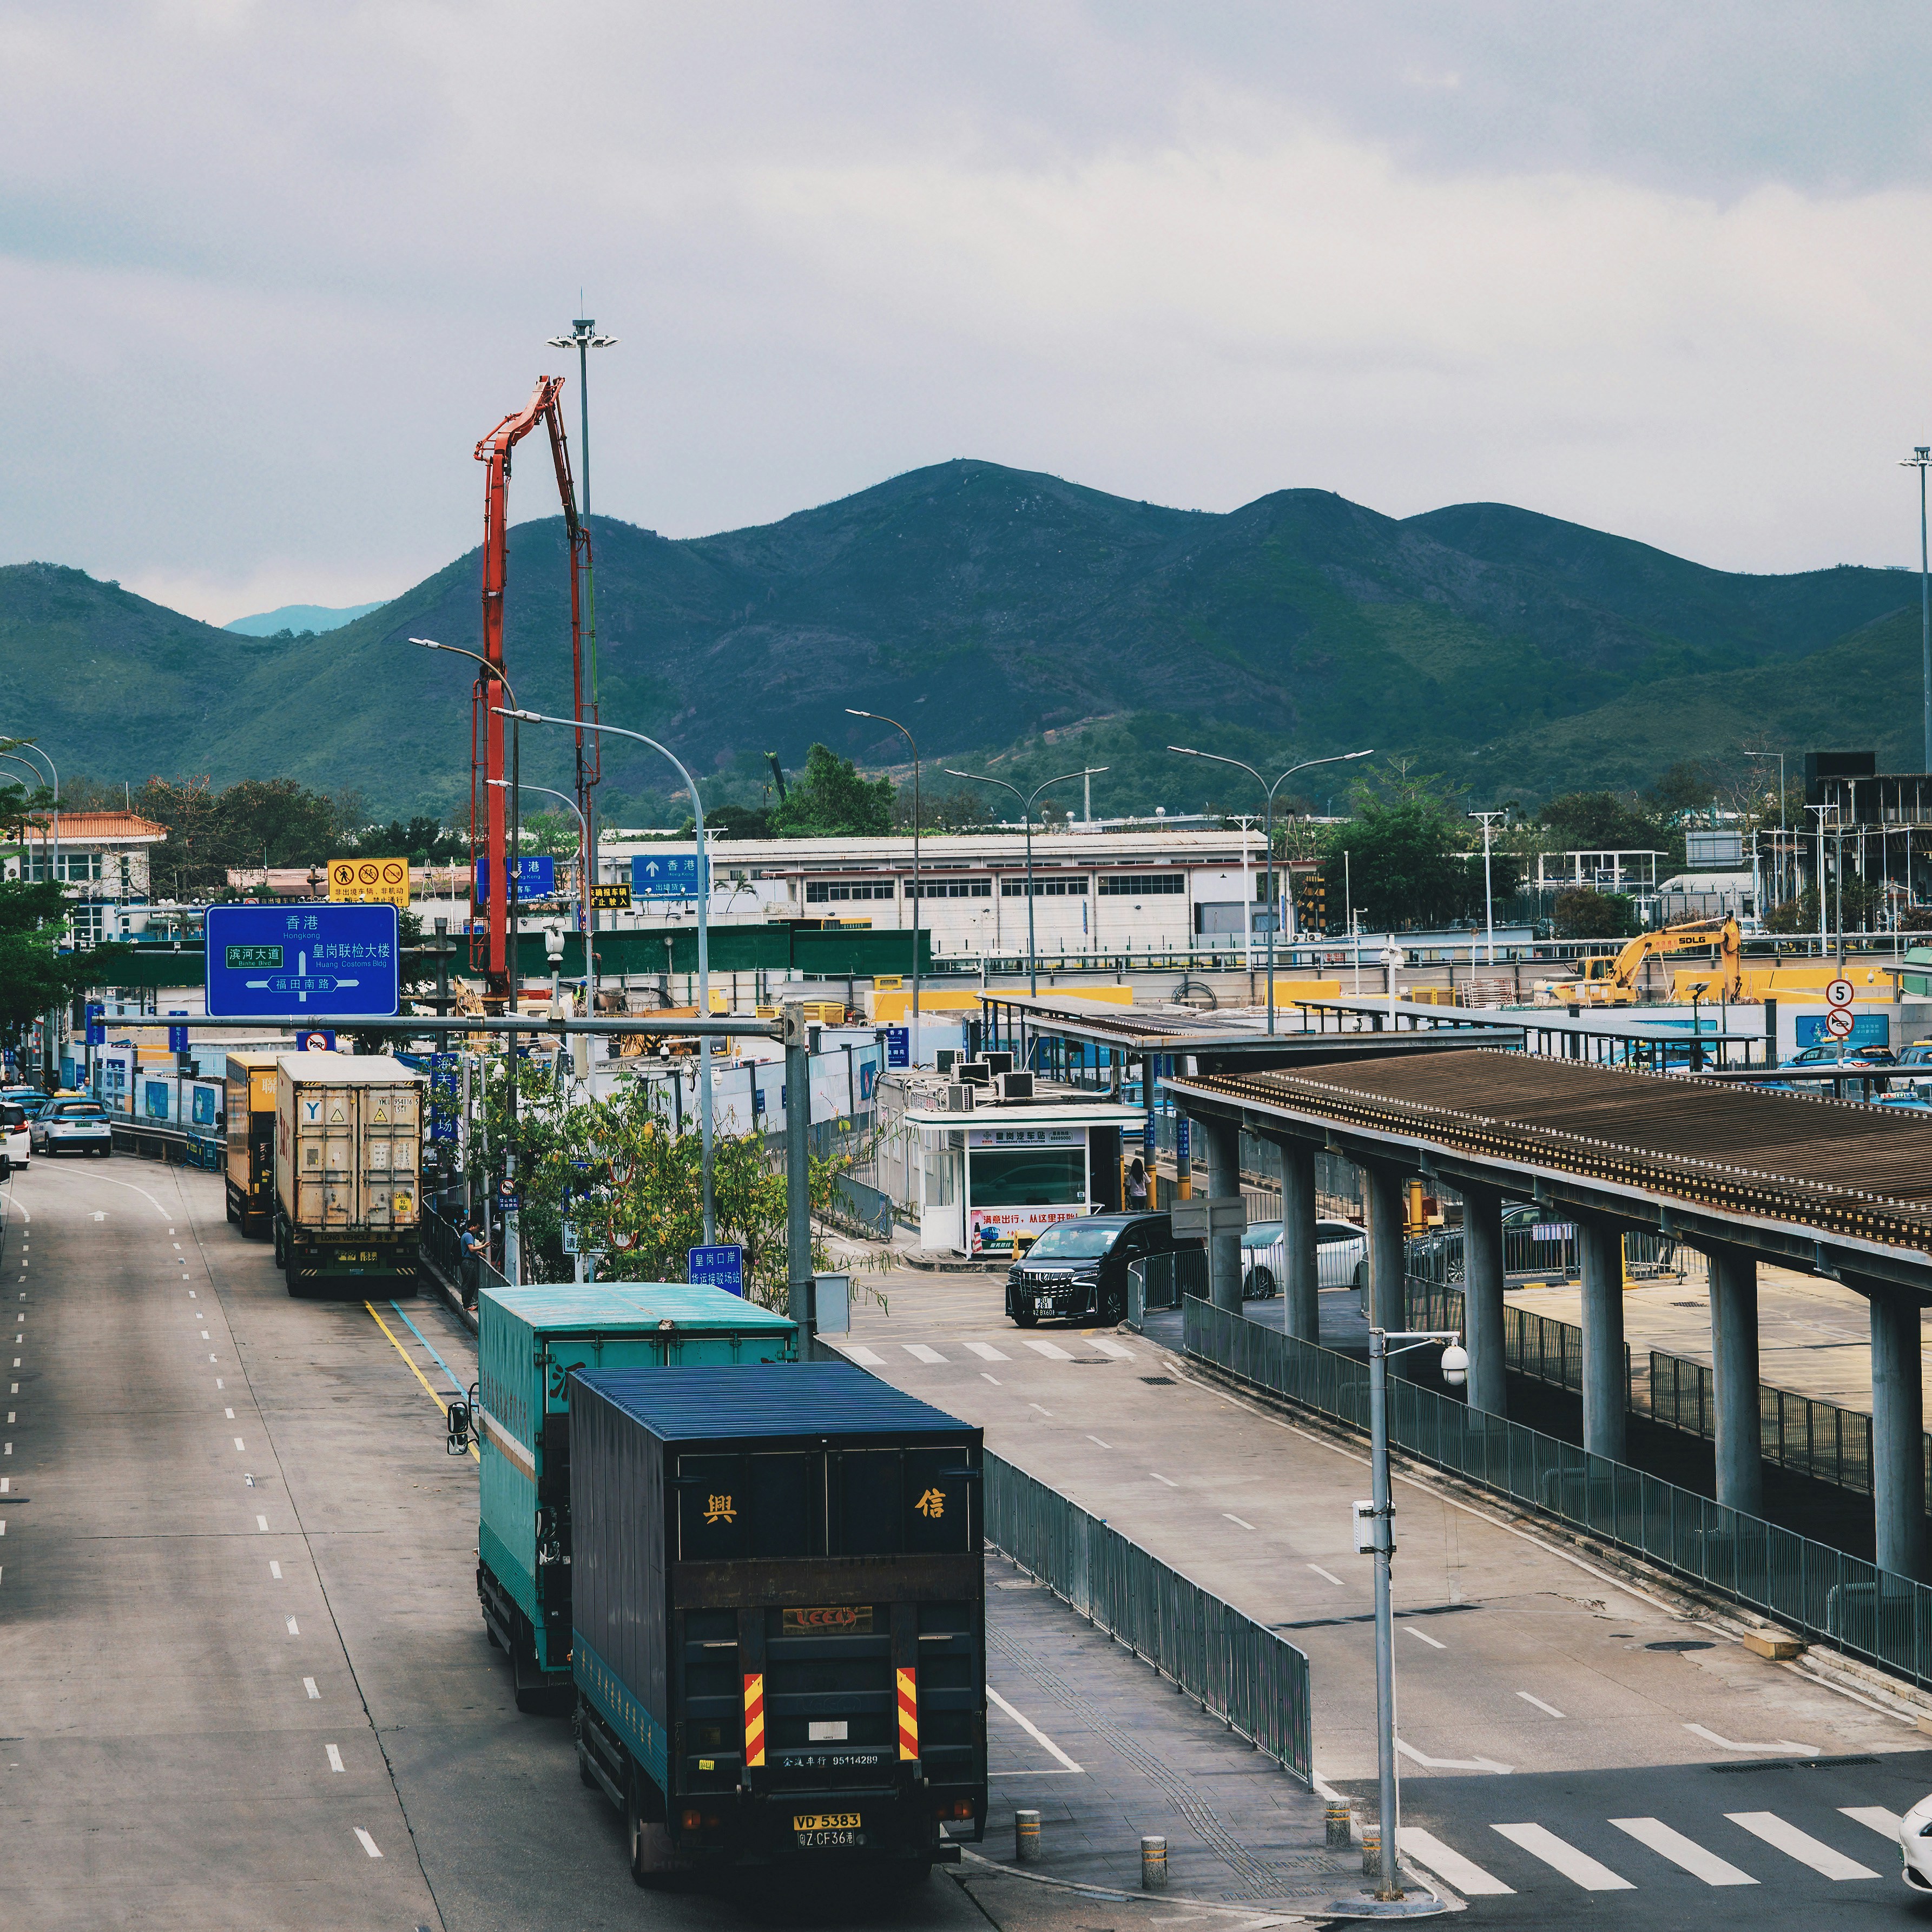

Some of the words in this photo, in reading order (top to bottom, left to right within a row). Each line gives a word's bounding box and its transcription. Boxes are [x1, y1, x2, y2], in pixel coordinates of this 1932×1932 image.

[668, 860, 694, 871] 香港
[286, 915, 319, 930] 香港
[230, 948, 280, 960] 滨河大道
[312, 943, 390, 958] 皇岗联检大楼
[373, 960, 386, 968] Bldg
[276, 978, 329, 990] 福田南路
[1836, 986, 1845, 1000] 5
[996, 1131, 1045, 1140] 皇岗汽车站
[696, 1251, 735, 1267] 皇岗口岸
[692, 1271, 740, 1285] 货运接驳场站
[703, 1494, 737, 1524] 興
[915, 1488, 946, 1518] 信
[833, 1756, 878, 1765] 95114289
[797, 1816, 815, 1828] VD
[821, 1815, 858, 1827] 5383
